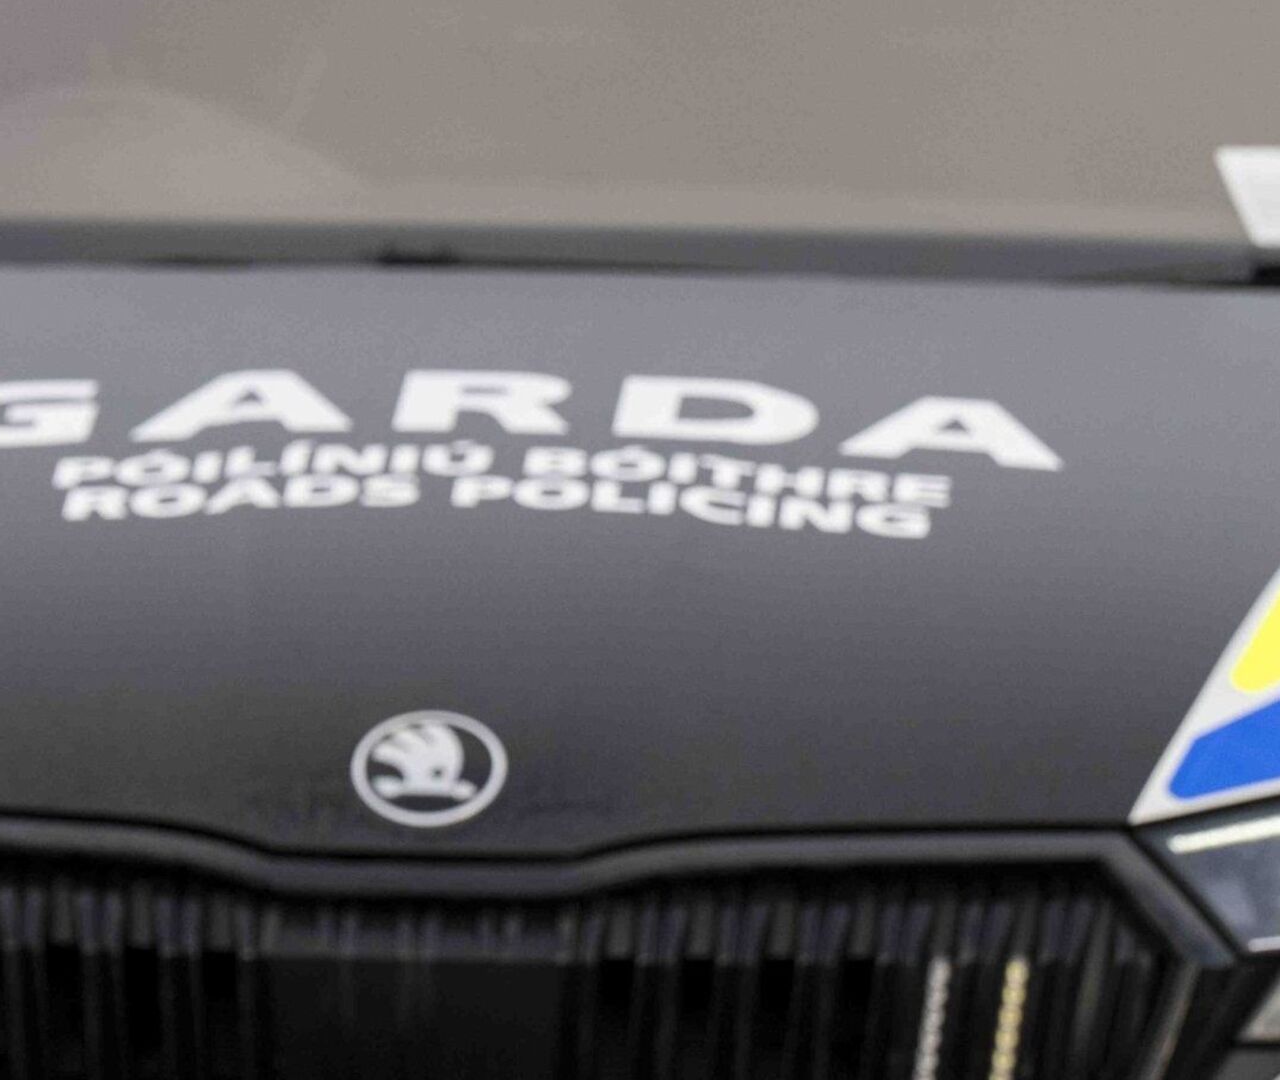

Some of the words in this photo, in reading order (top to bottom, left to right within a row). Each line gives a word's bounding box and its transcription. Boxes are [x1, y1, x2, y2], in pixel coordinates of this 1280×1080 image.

[53, 438, 495, 490] PÓILÍNIÚ
[523, 445, 952, 508] BÓITHRE
[61, 473, 420, 521] ROADS
[450, 474, 932, 539] POLICING
